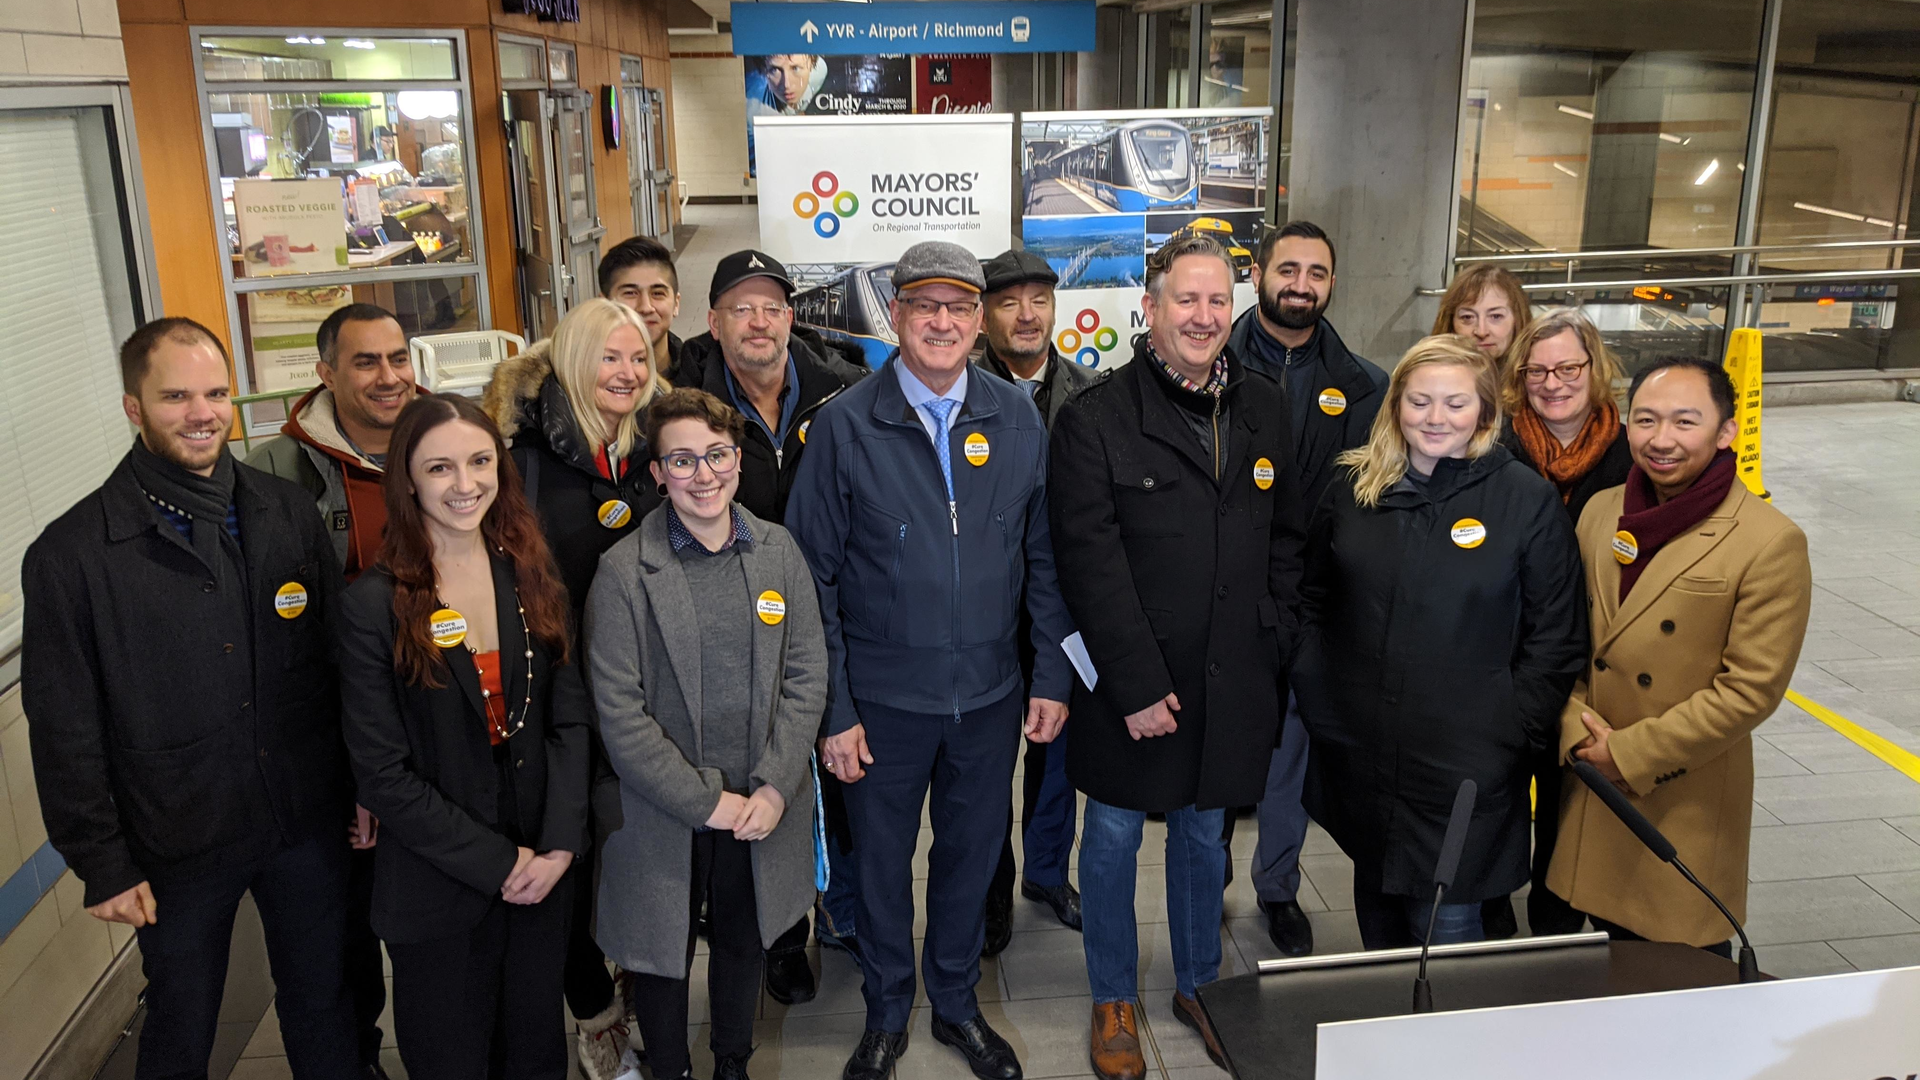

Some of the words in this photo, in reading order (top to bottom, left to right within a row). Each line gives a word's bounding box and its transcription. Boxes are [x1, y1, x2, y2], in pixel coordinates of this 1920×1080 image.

[826, 23, 855, 38] YVR
[868, 22, 917, 41] Airport
[934, 21, 1003, 38] Richmond
[933, 74, 948, 83] KPU
[814, 94, 862, 113] Cindy
[246, 204, 296, 213] ROASTED
[299, 203, 337, 212] VEGGIE
[871, 197, 980, 217] COUNCIL
[872, 222, 885, 232] On
[886, 222, 921, 233] Regional
[923, 220, 981, 232] Transportation
[1747, 416, 1757, 425] WET
[1743, 426, 1758, 436] FLOOR
[1745, 443, 1756, 452] PISO
[1740, 453, 1760, 463] MOJADO
[277, 599, 306, 607] Congestion
[432, 625, 465, 635] ongestion
[436, 621, 456, 629] #Cure
